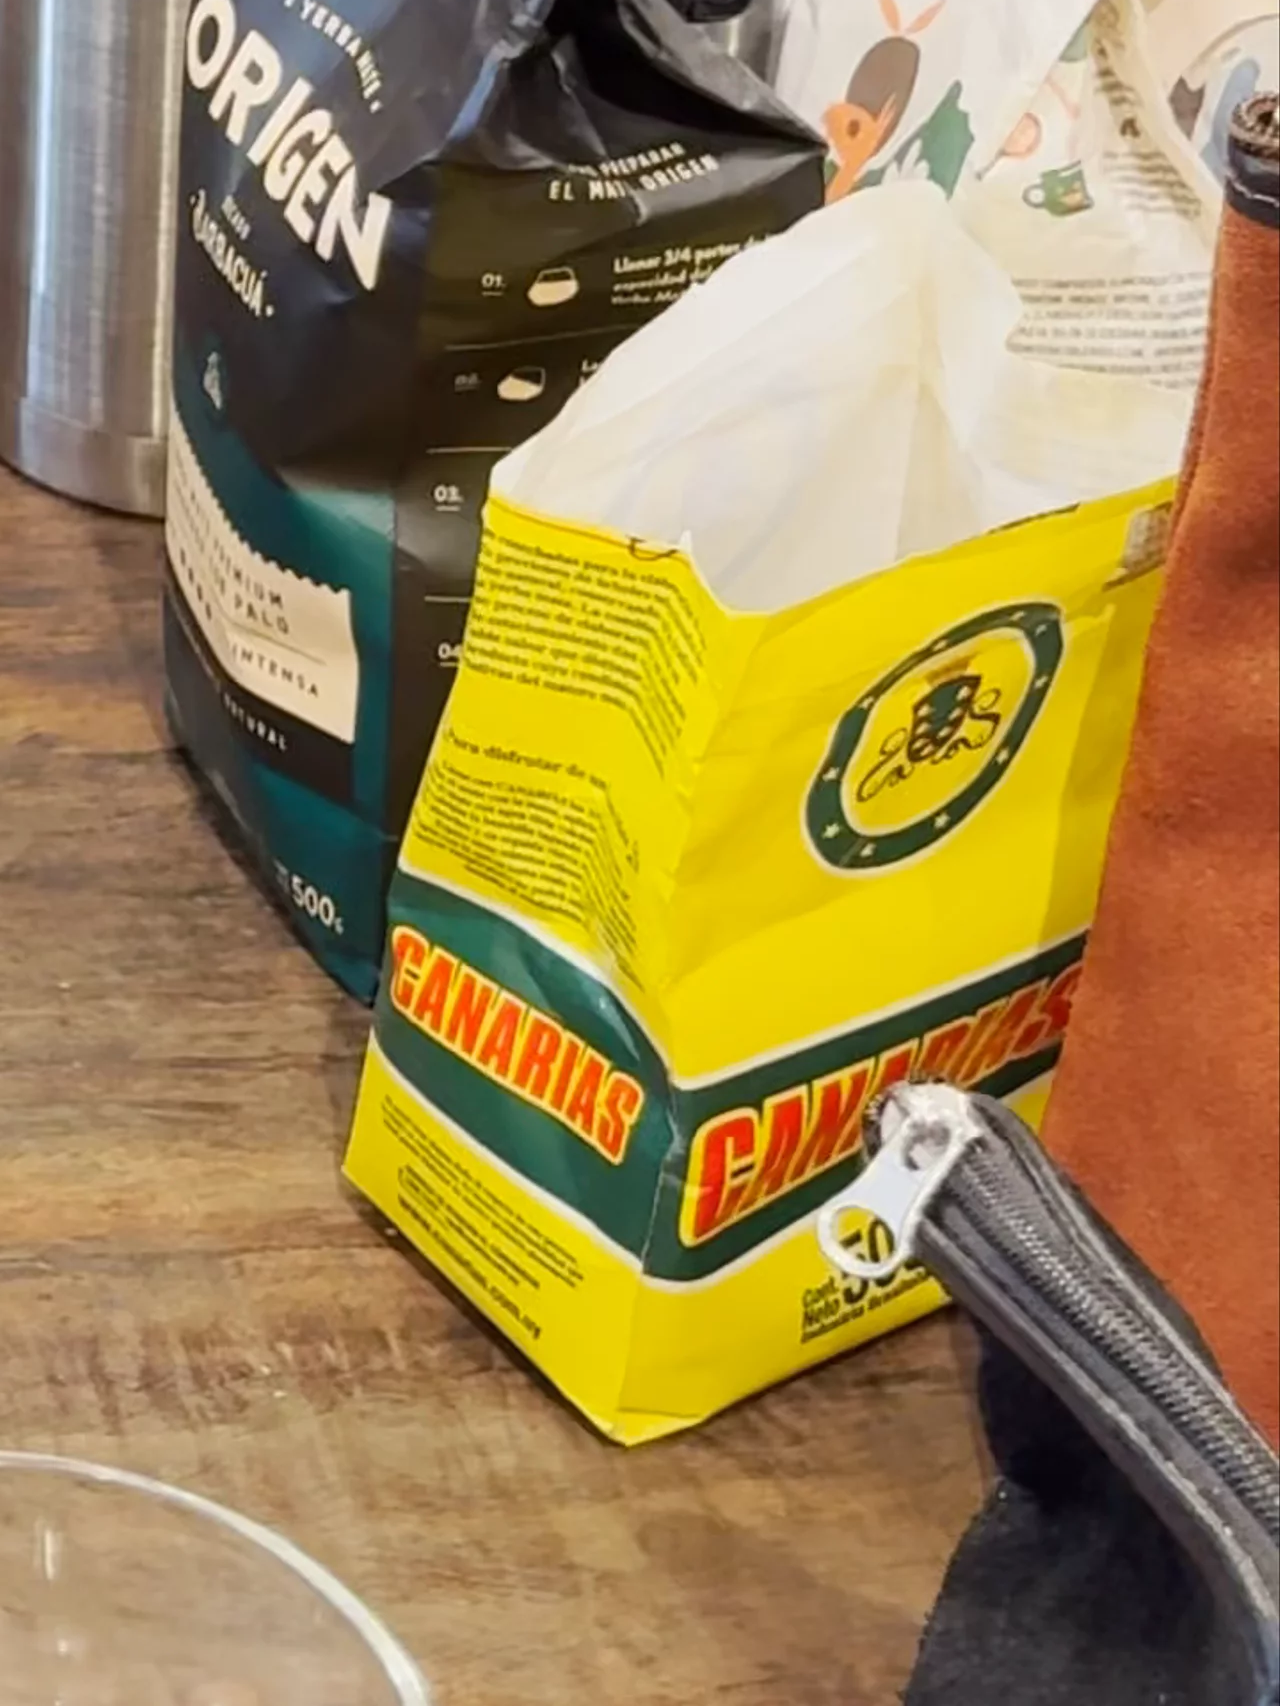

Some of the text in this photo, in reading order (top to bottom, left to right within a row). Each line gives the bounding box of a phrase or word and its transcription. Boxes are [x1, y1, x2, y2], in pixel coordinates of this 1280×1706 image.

[549, 153, 720, 202] EL MAT ORIGEN
[391, 925, 645, 1166] CANARIAS
